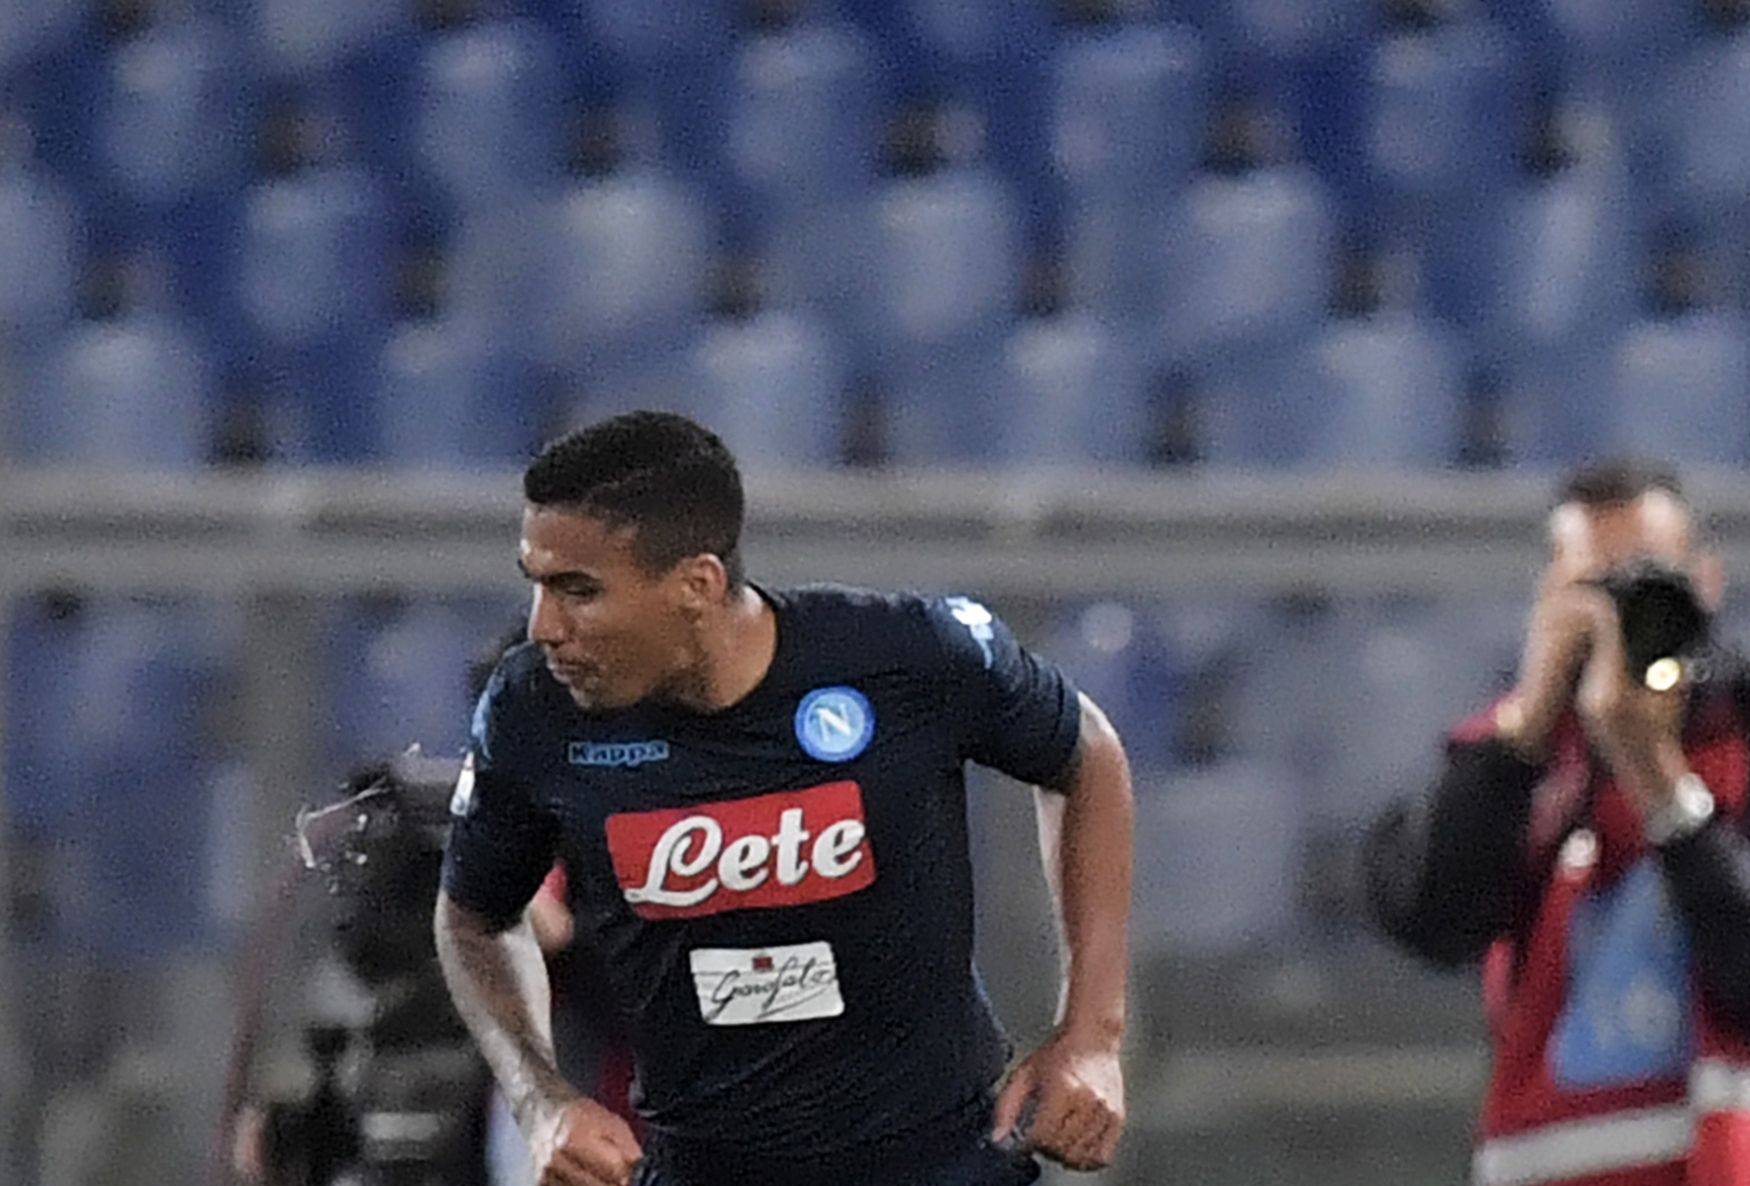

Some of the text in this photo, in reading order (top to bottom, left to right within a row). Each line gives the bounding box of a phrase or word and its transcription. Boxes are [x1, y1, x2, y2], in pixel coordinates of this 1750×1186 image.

[815, 703, 851, 741] N
[569, 740, 669, 767] Kappa
[624, 807, 866, 906] Lete
